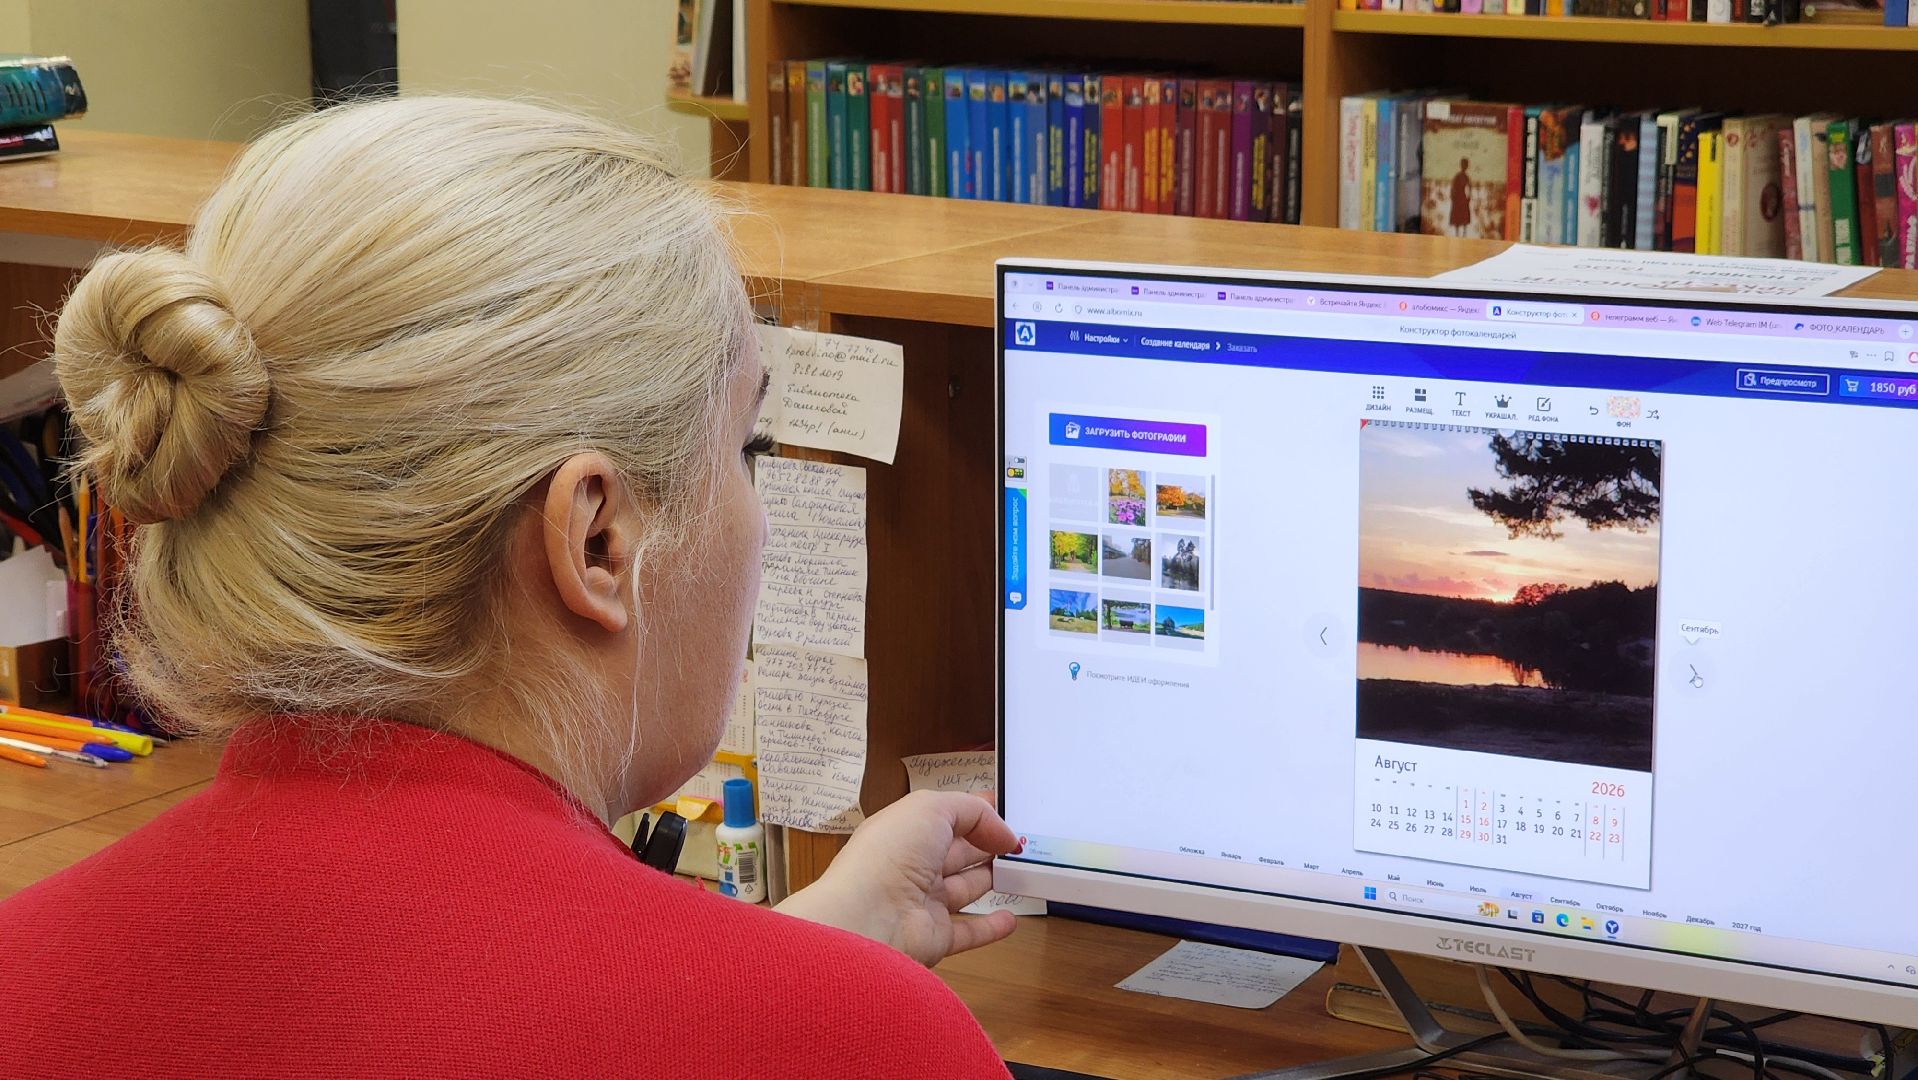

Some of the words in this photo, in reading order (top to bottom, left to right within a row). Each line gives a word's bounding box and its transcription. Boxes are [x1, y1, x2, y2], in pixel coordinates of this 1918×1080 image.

[1087, 306, 1143, 318] www.albomix.ru
[1506, 308, 1551, 319] Конструктор
[1706, 318, 1723, 327] Web
[1724, 319, 1757, 329] Telegram
[1084, 333, 1120, 344] Настройки
[1400, 325, 1449, 337] Конструктор
[1450, 328, 1517, 341] фотокалендарей
[1140, 337, 1173, 349] Создание
[1174, 340, 1210, 351] календаря
[1227, 343, 1258, 353] Заказать
[1760, 376, 1818, 389] Предпросмотр
[1870, 382, 1896, 394] 1850
[1897, 384, 1917, 397] руб
[1365, 403, 1392, 412] ДИЗАЙН
[1451, 409, 1471, 418] ТЕКСТ
[1541, 415, 1559, 423] ФОНА
[1616, 420, 1632, 428] ФОН
[1084, 426, 1130, 439] ЗАГРУЗИТЬ
[1131, 431, 1187, 443] ФОТОГРАФИИ
[1011, 497, 1019, 527] вопрос
[1011, 546, 1020, 581] Задайте
[1681, 623, 1719, 635] Сентябрь
[1086, 671, 1126, 683] Посмотрите
[1148, 677, 1190, 690] оформления
[1374, 754, 1417, 774] Август
[1591, 781, 1625, 798] 2026
[1371, 803, 1381, 813] 10
[1389, 805, 1399, 815] 11
[1407, 807, 1417, 818] 12
[1424, 809, 1435, 820] 13
[1442, 812, 1453, 822] 14
[1460, 814, 1472, 824] 15
[1479, 817, 1489, 827] 16
[1497, 819, 1507, 829] 17
[1515, 821, 1526, 831] 18
[1534, 824, 1545, 834] 19
[1552, 826, 1564, 836] 20
[1570, 828, 1582, 839] 21
[1589, 831, 1601, 841] 22
[1608, 833, 1620, 844] 23
[1370, 818, 1382, 828] 24
[1388, 820, 1400, 830] 25
[1405, 822, 1417, 833] 26
[1423, 824, 1435, 834] 27
[1441, 827, 1453, 837] 28
[1459, 829, 1471, 840] 29
[1478, 832, 1490, 842] 30
[1495, 834, 1507, 845] 31
[1179, 845, 1205, 855] Обложка
[1258, 856, 1285, 866] Февраль
[1303, 862, 1320, 871] Март
[1341, 867, 1364, 877] Апрель
[1387, 873, 1401, 881] Май
[1426, 879, 1445, 888] Июнь
[1402, 893, 1425, 904] Поиск
[1510, 891, 1533, 901] Август
[1550, 896, 1581, 907] Сентябрь
[1595, 902, 1624, 914] Октябрь
[1642, 909, 1668, 919] Ноябрь
[1685, 915, 1715, 926] Декабрь
[1731, 921, 1749, 931] 2027
[1453, 937, 1535, 962] TECLAST
